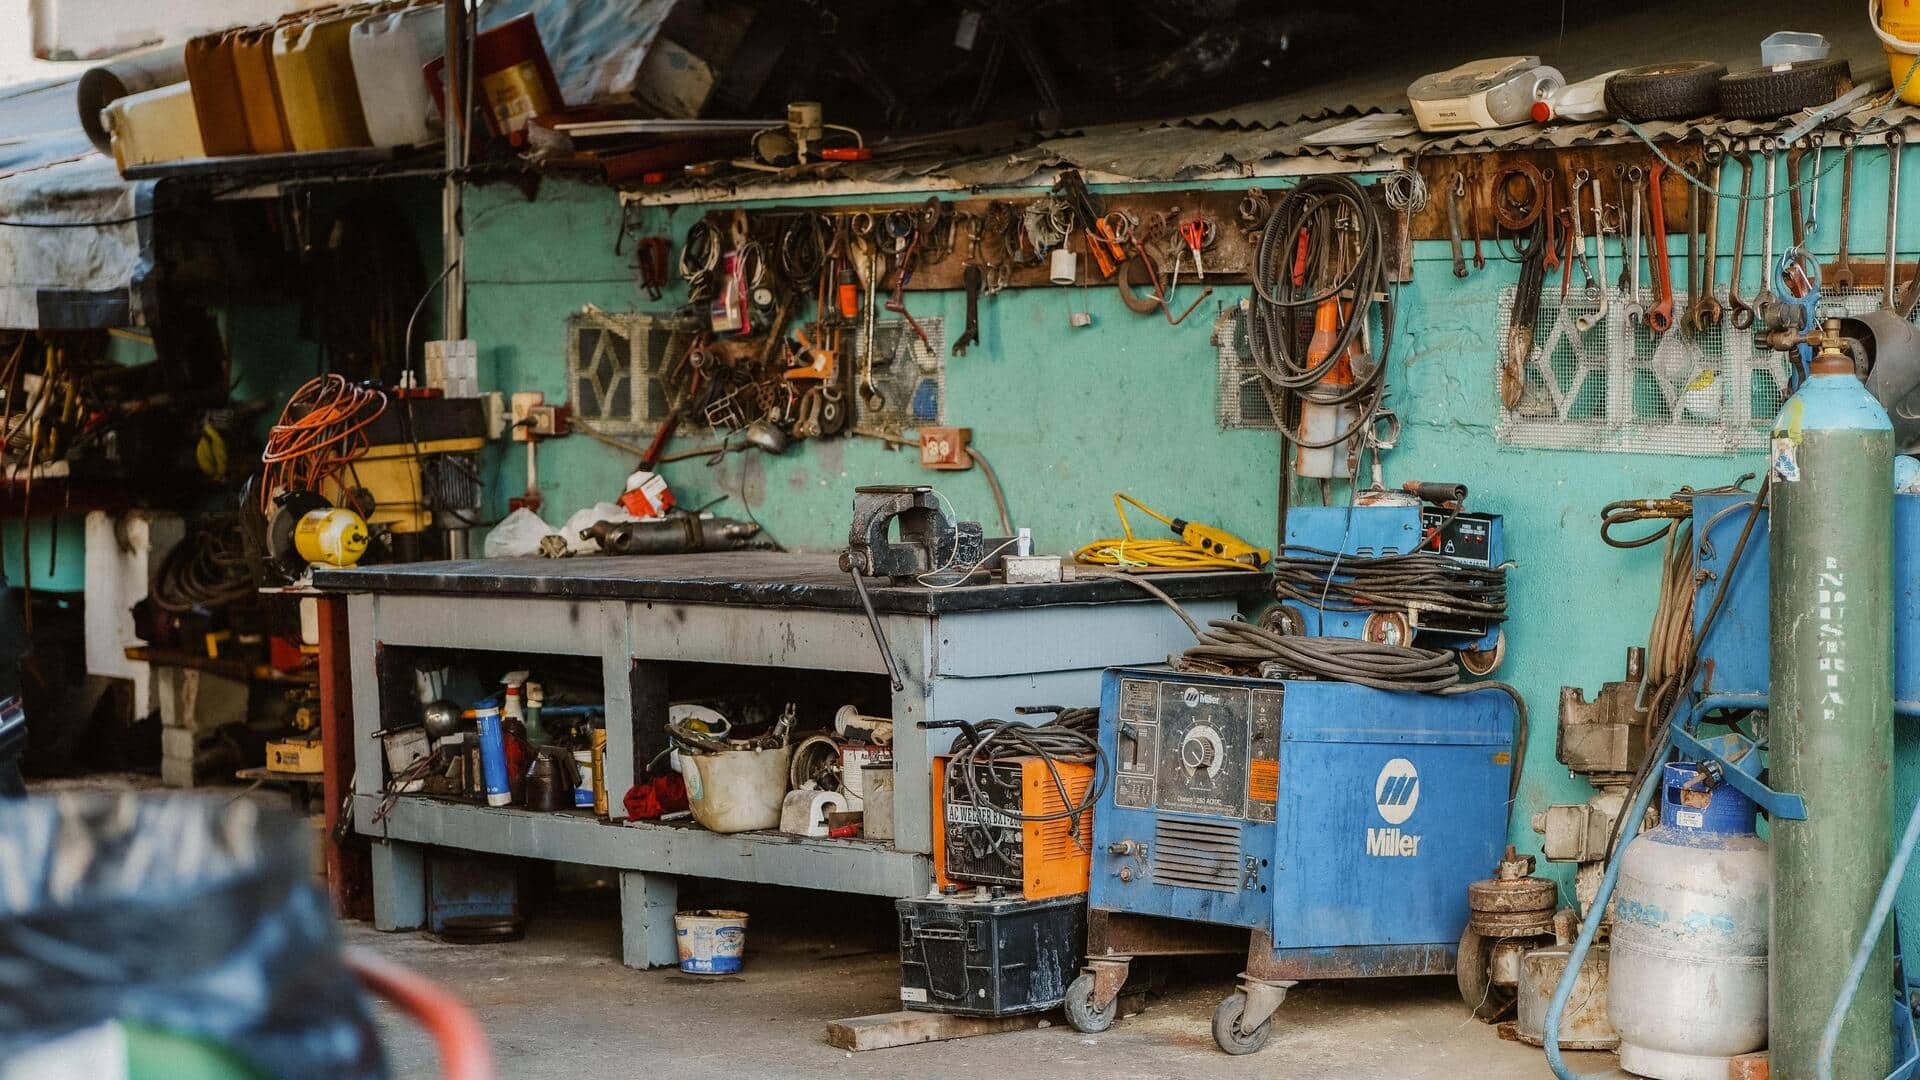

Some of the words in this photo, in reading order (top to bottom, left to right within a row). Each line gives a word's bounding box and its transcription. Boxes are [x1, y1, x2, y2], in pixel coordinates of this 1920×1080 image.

[949, 806, 959, 821] AC
[960, 806, 991, 824] WELER
[1366, 827, 1422, 857] Miller
